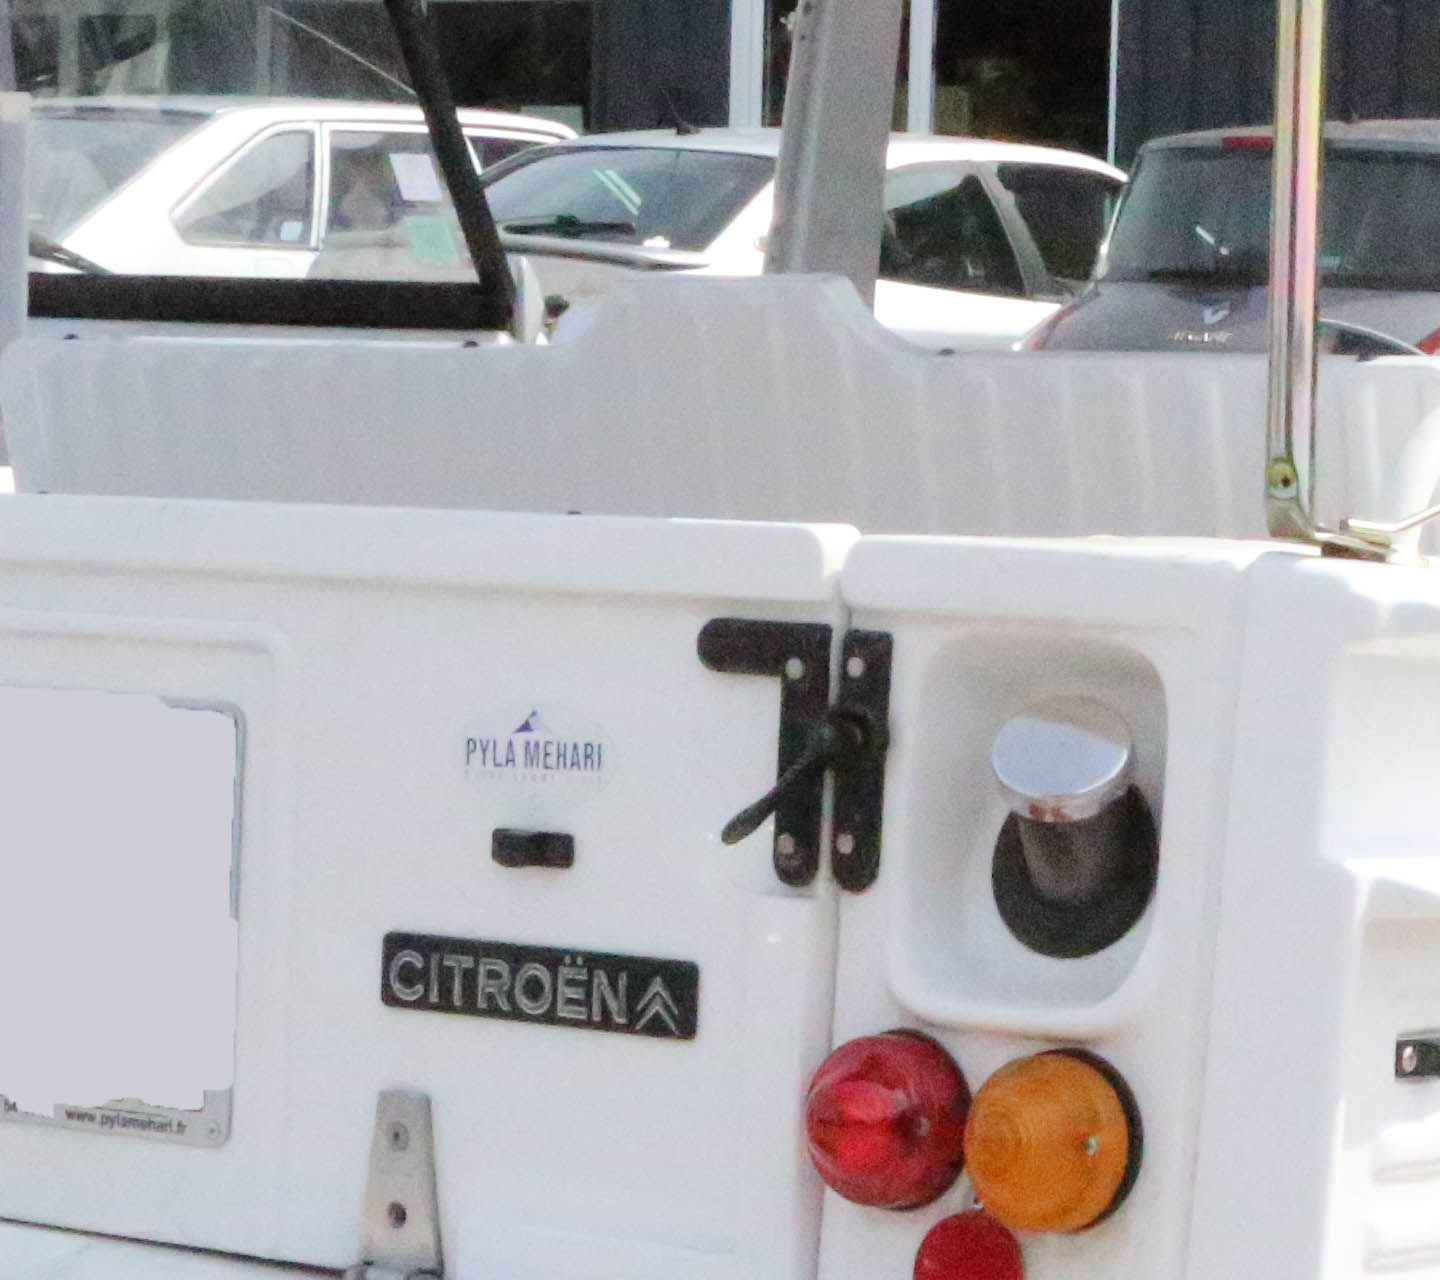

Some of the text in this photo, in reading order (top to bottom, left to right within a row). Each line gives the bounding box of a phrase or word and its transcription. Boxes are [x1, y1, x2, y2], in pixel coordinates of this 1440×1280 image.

[465, 737, 603, 772] PYLA MEHARI
[388, 949, 629, 1025] CITROËN
